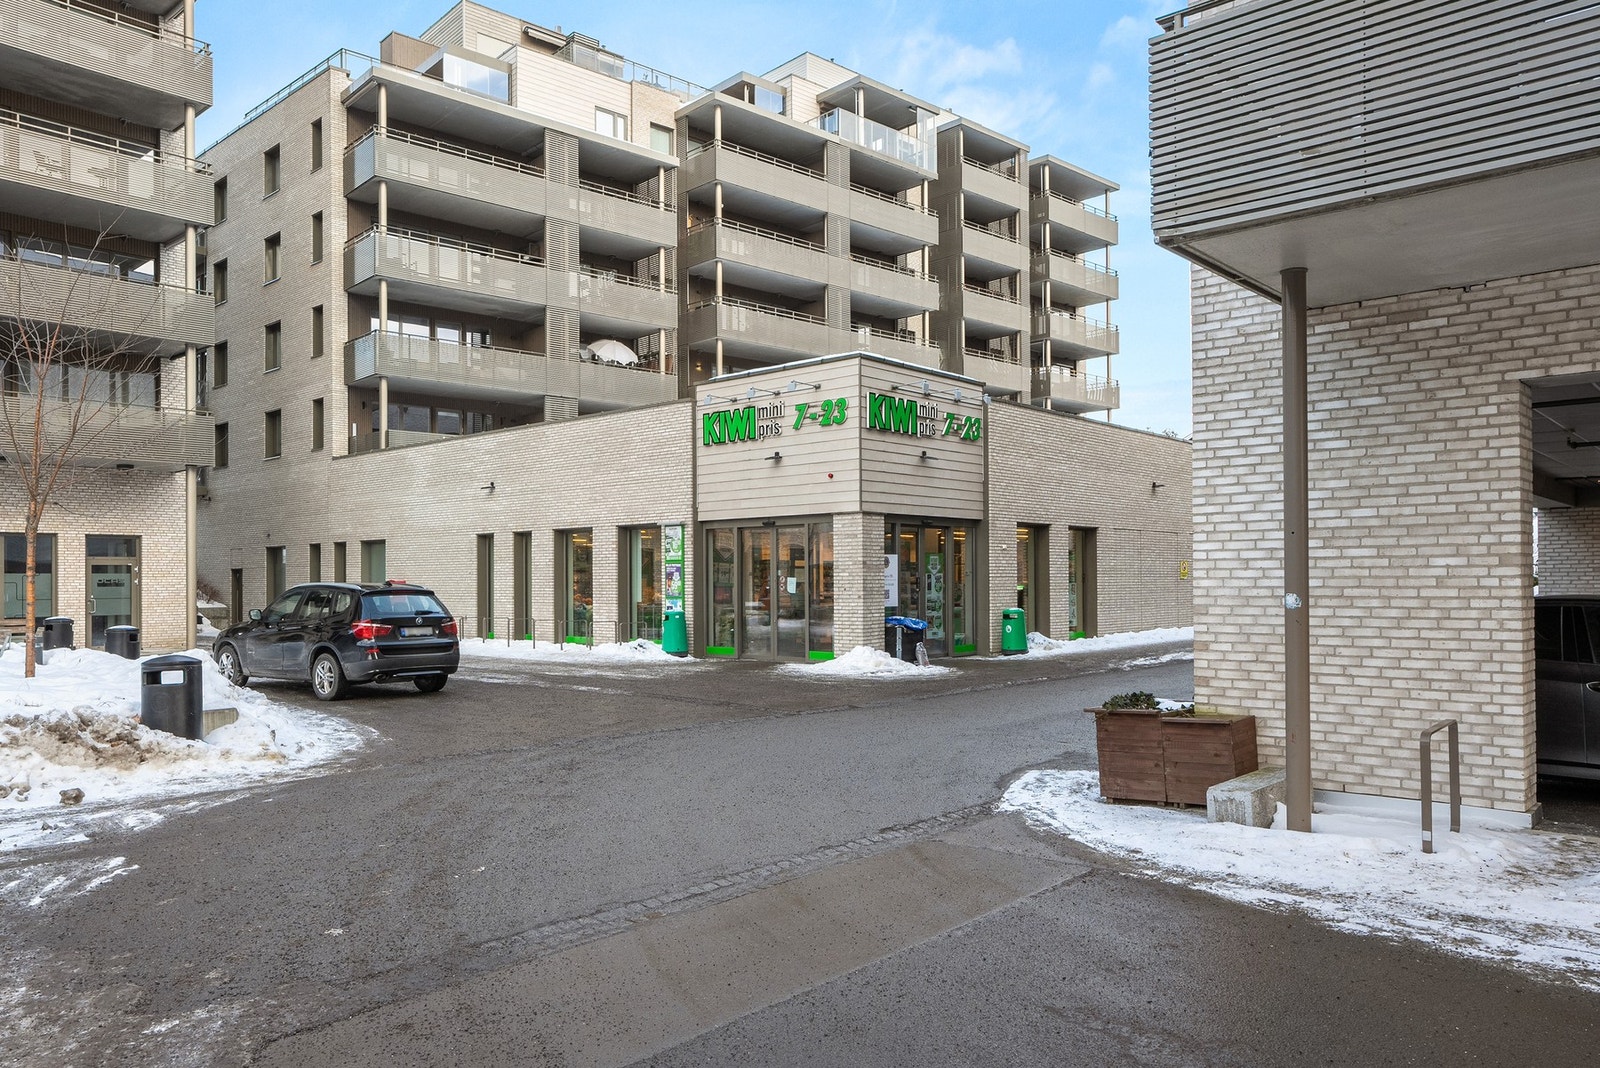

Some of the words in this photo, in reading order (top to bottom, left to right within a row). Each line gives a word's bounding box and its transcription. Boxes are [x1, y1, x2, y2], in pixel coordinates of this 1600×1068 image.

[702, 406, 757, 446] KIWI
[758, 401, 785, 418] mini
[793, 398, 848, 430] 7-23
[758, 420, 782, 440] pris
[867, 391, 918, 435] KIWI
[918, 402, 938, 419] mini
[942, 412, 981, 441] 7-23
[918, 420, 936, 437] pris
